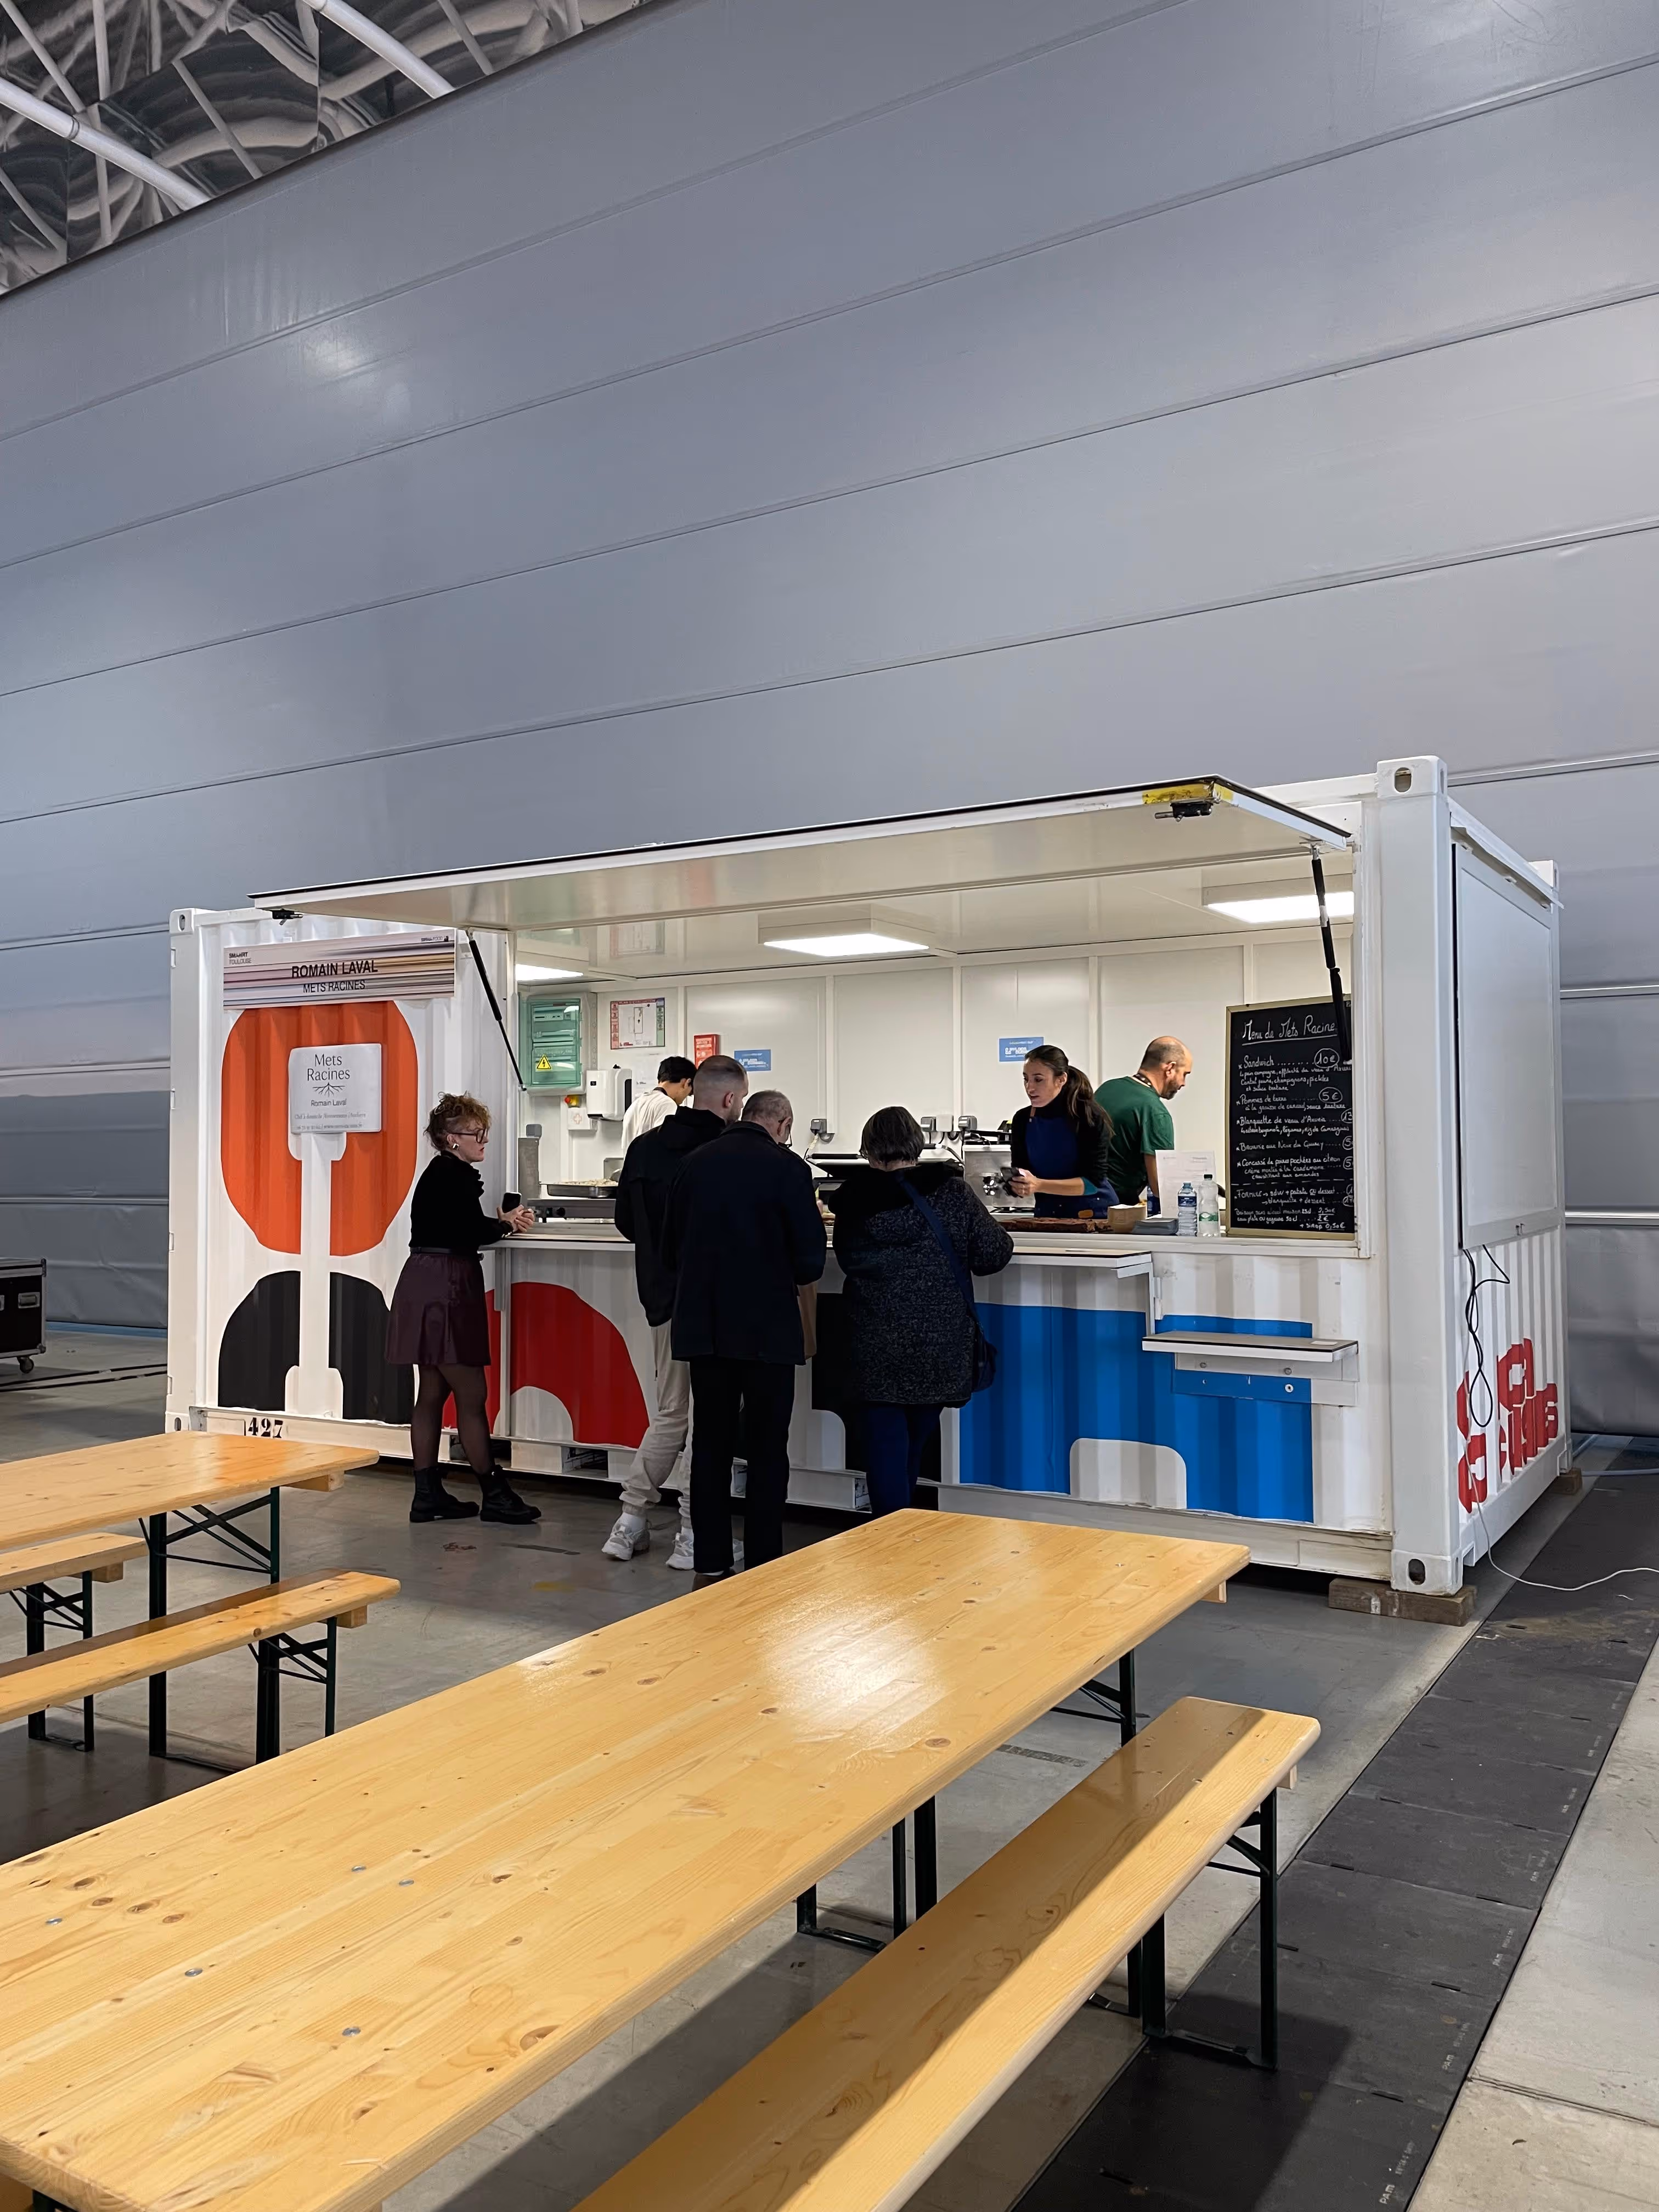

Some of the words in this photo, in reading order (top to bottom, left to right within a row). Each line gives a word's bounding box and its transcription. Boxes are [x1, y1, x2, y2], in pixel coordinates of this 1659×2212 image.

[291, 963, 338, 978] ROMAIN
[342, 960, 378, 974] LAVAL
[303, 982, 326, 993] METS
[329, 979, 365, 992] RACINES
[1242, 1019, 1263, 1040] Menu
[1265, 1021, 1274, 1039] de
[1279, 1017, 1299, 1038] Mets
[314, 1053, 342, 1066] Mets
[1243, 1054, 1274, 1069] Sandwich
[307, 1068, 350, 1081] Racines
[332, 1098, 347, 1106] Laval
[1240, 1093, 1263, 1105] Pommes
[1240, 1114, 1272, 1128] Blanquette
[1242, 1158, 1266, 1166] Concassé
[1267, 1156, 1273, 1165] de
[248, 1417, 284, 1438] 427
